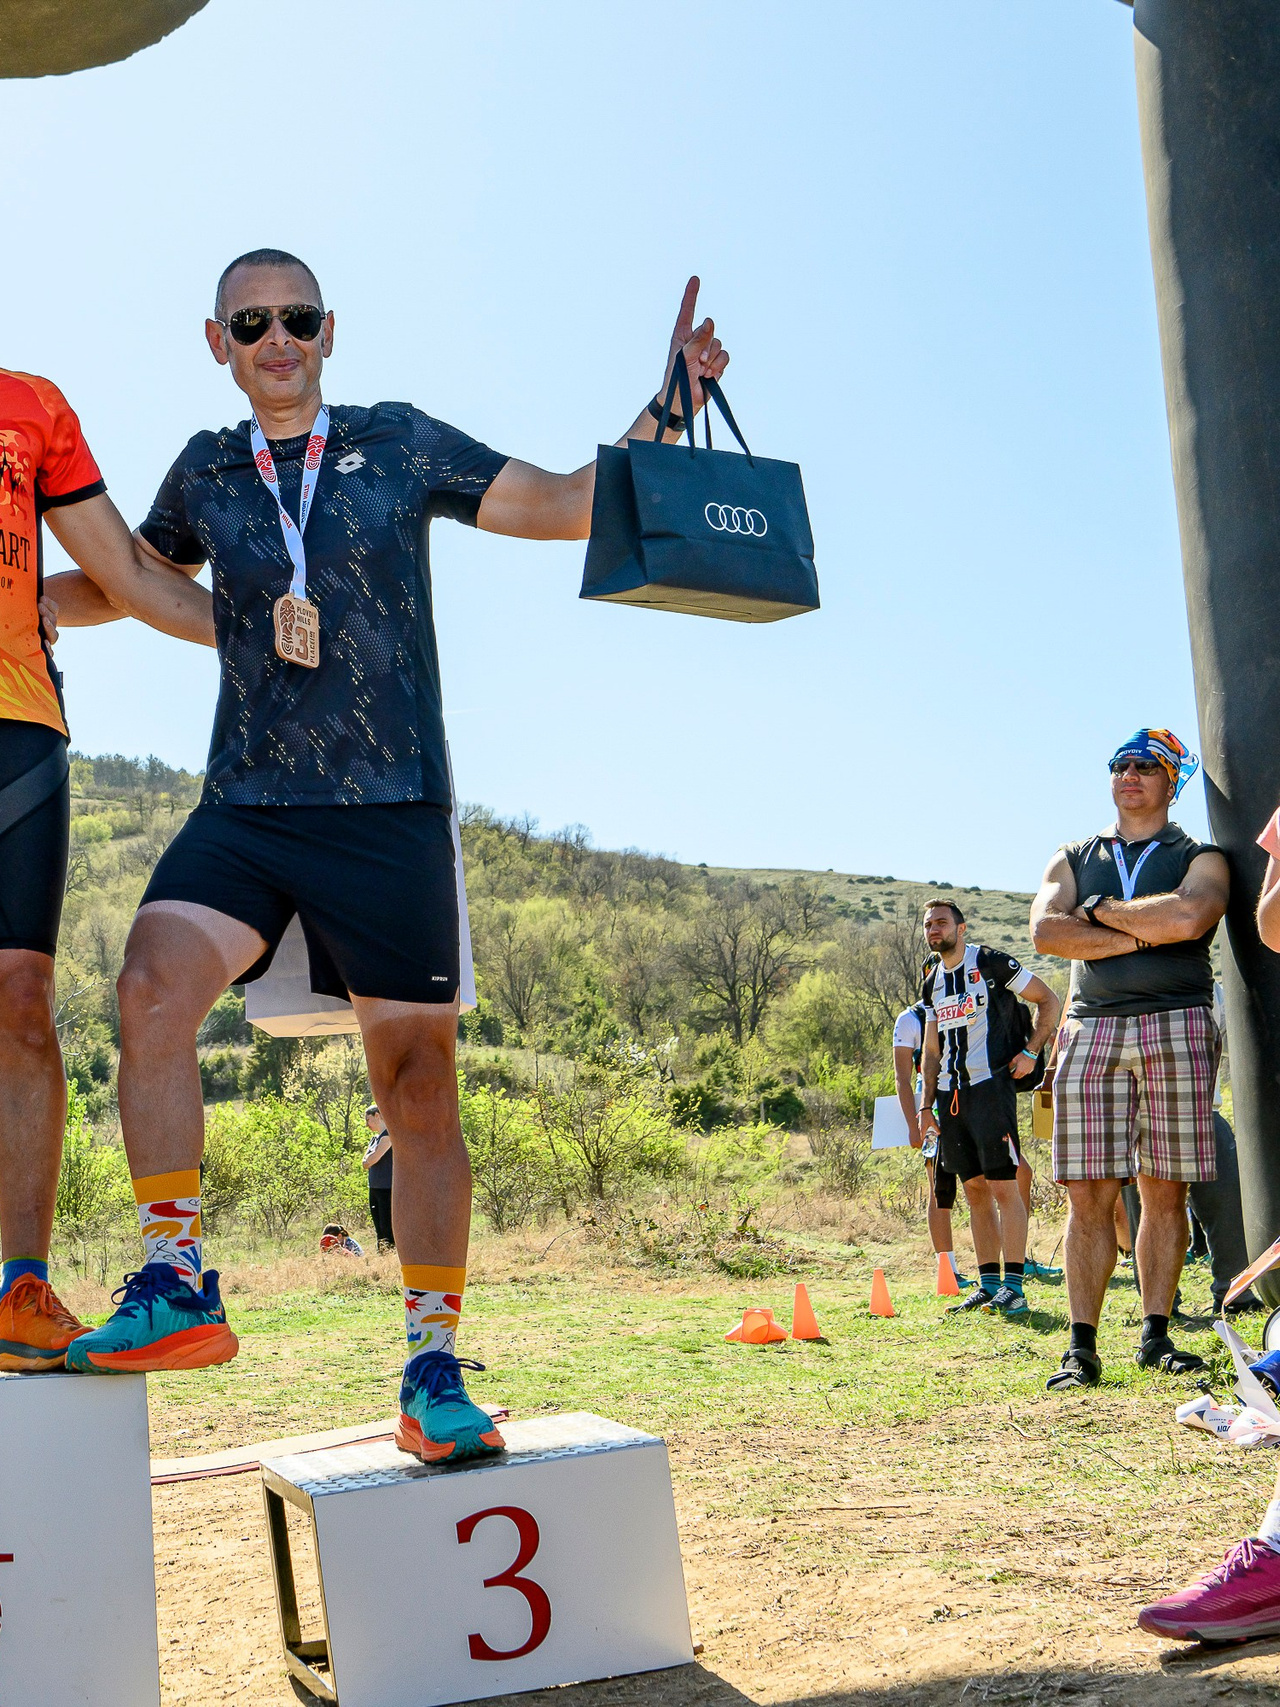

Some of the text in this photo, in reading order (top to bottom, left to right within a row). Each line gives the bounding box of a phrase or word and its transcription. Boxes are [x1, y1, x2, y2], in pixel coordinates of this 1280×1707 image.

[296, 605, 318, 620] PLOVDIV
[294, 625, 309, 661] 3
[454, 1505, 552, 1661] 3
